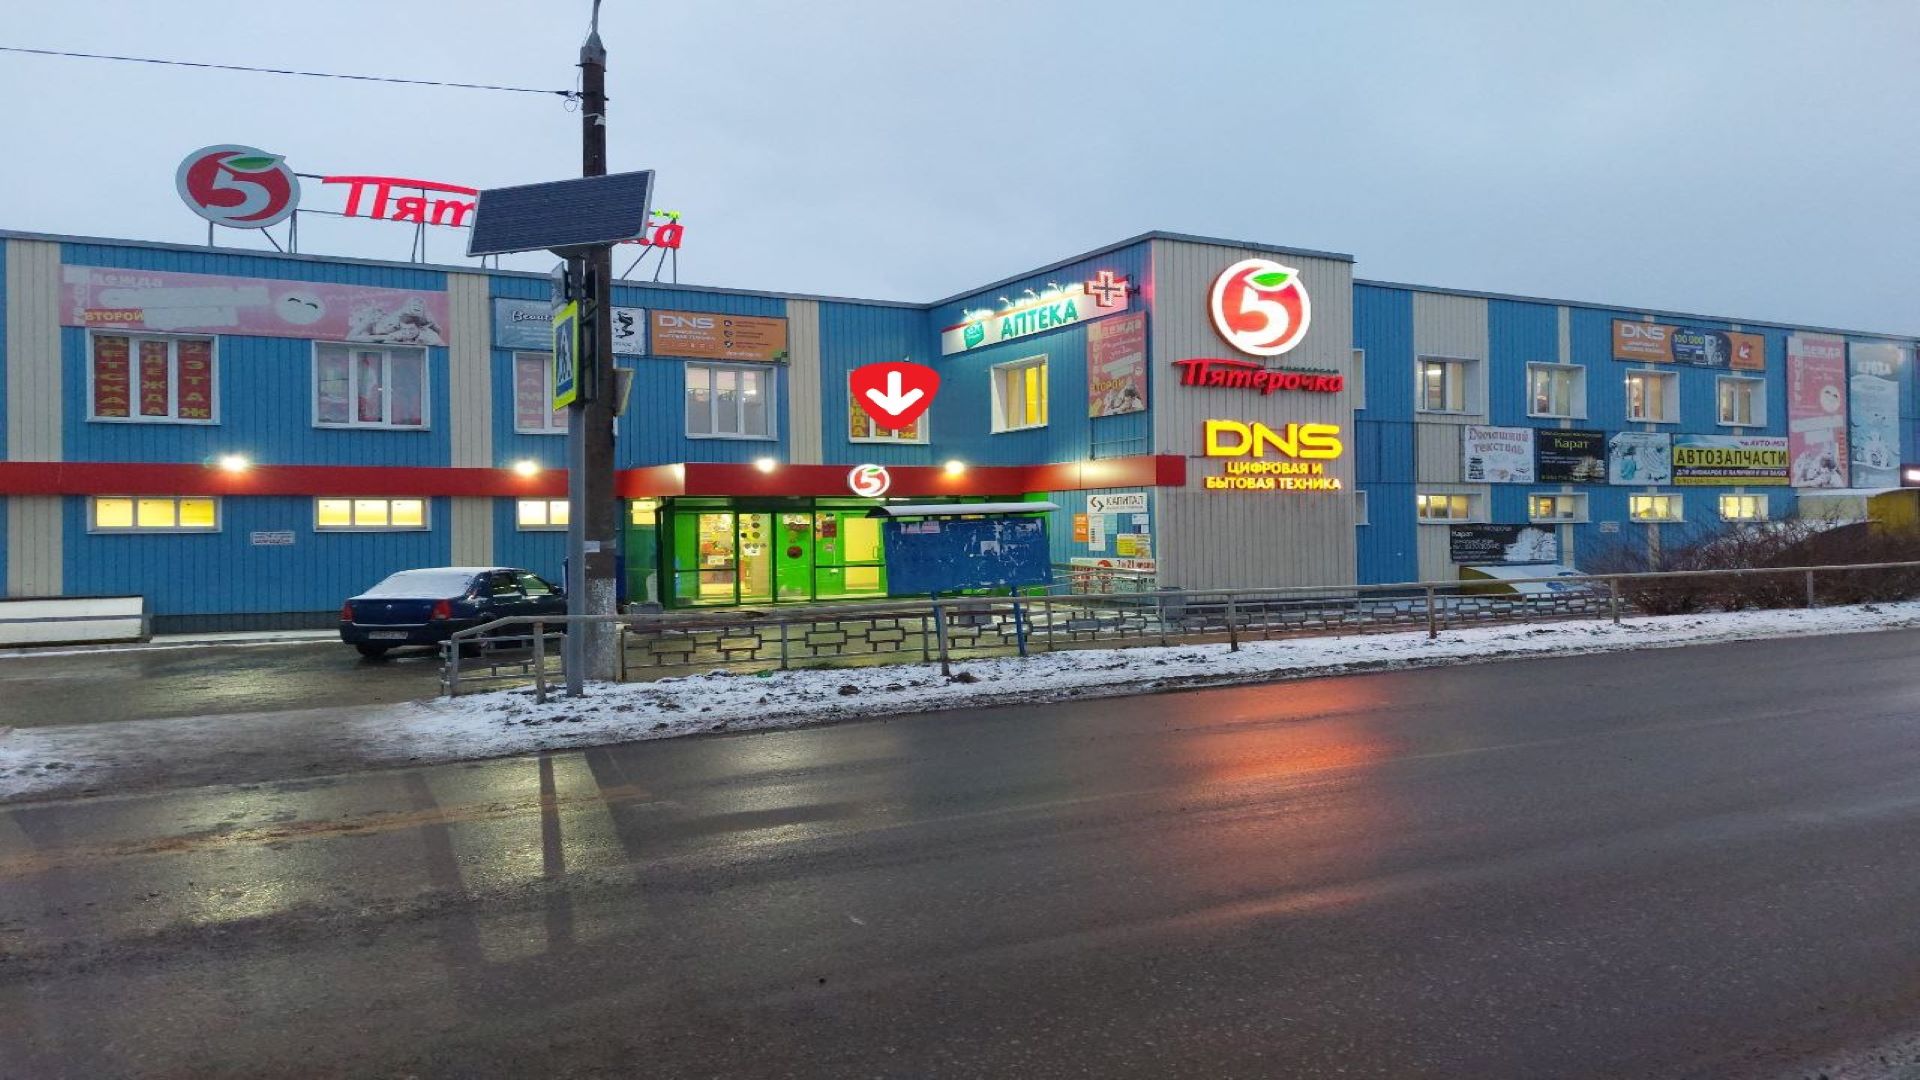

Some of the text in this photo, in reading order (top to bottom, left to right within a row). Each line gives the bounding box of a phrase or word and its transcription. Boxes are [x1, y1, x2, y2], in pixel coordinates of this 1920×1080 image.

[658, 315, 715, 328] DNS
[1001, 299, 1078, 339] АПТЕКА
[1621, 324, 1666, 340] DNS
[1203, 419, 1343, 459] DNS
[1555, 438, 1590, 451] Карат
[1676, 449, 1787, 465] АВТОЗАПЧАСТИ
[1225, 461, 1322, 475] ЦИФРОВАЯ И
[1205, 476, 1342, 490] БЫТОВАЯ ТЕХНИКА
[1106, 495, 1144, 506] КАПИТАЛ
